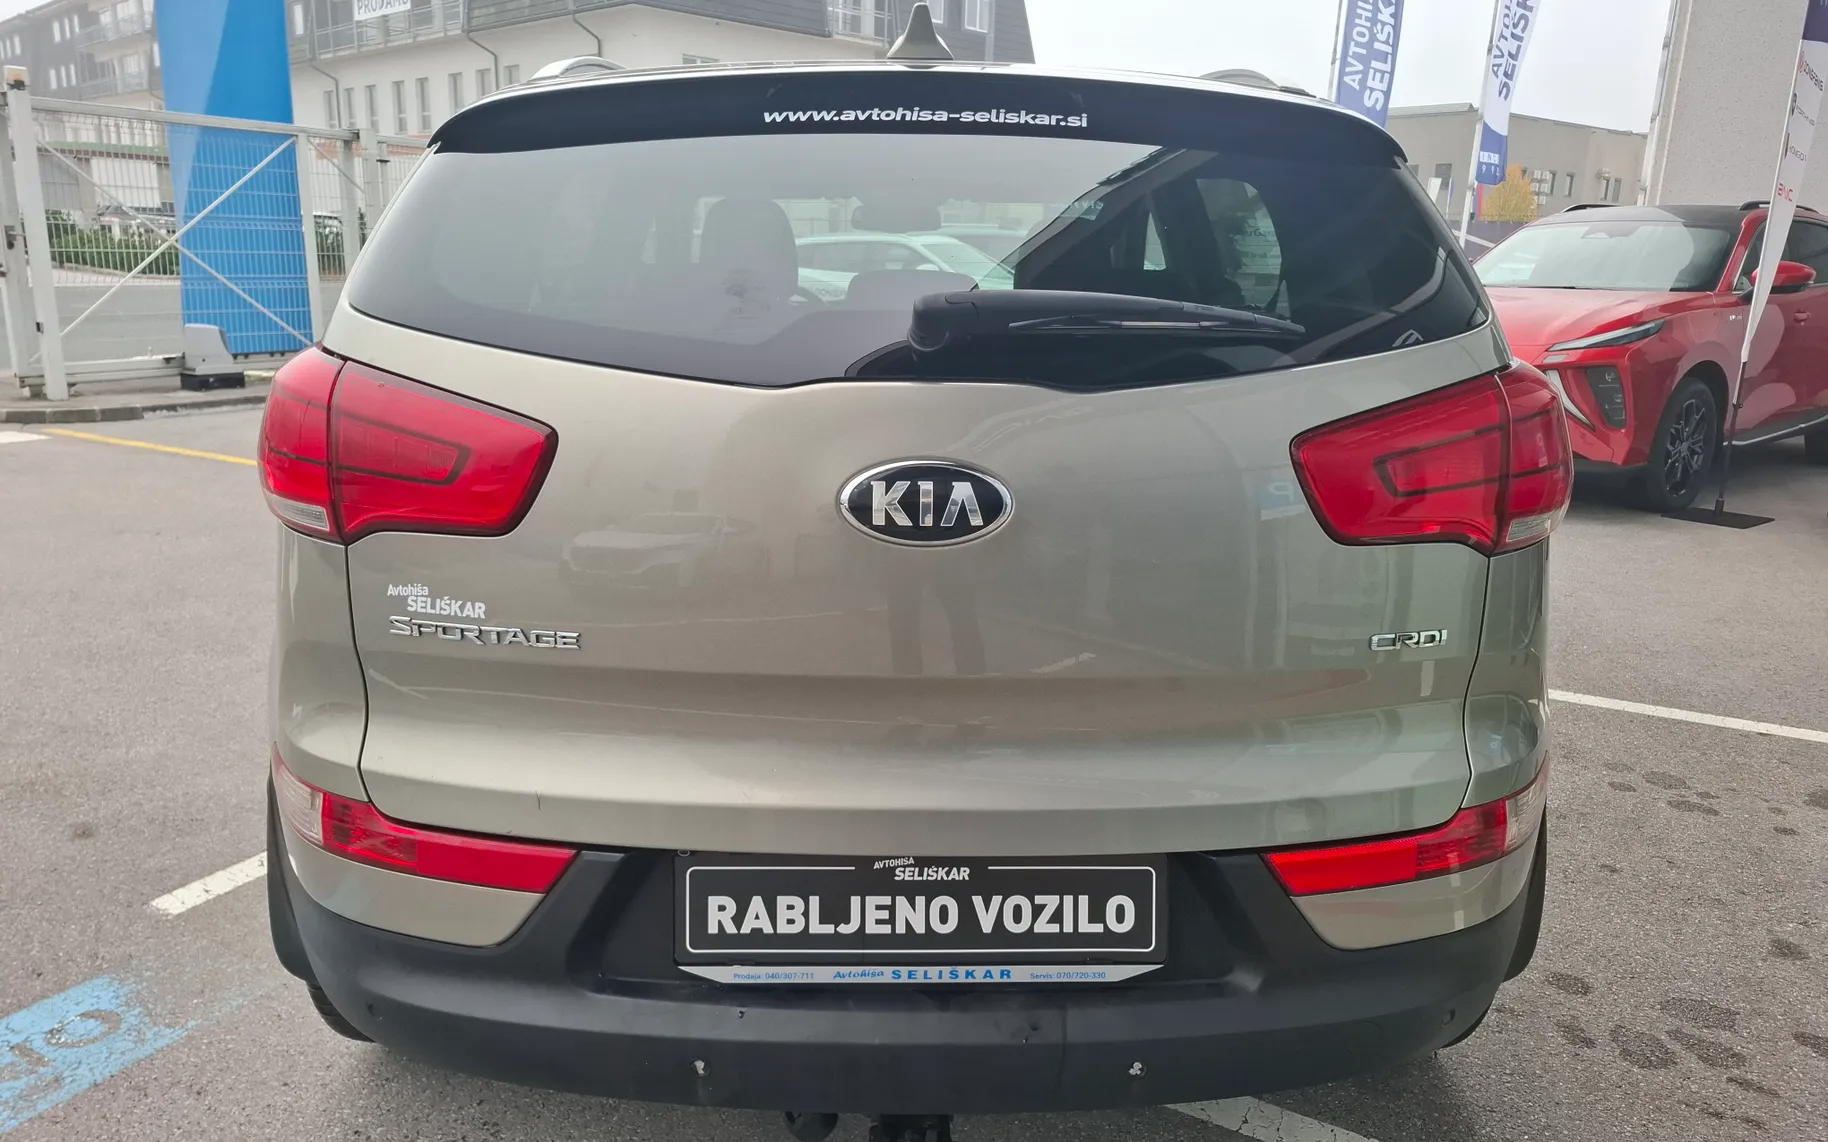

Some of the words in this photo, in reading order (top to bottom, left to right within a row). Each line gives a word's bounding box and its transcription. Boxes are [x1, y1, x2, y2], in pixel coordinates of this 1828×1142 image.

[1343, 0, 1373, 91] AVTOHI
[1363, 0, 1395, 111] SELIŠK
[763, 107, 1088, 127] www.avtohisa-seliskar.si
[870, 480, 984, 526] KIA
[387, 583, 429, 596] Avtohiša
[406, 596, 486, 619] SELIŠKAR
[894, 865, 970, 881] SELIŠKAR
[707, 895, 959, 935] RABLJENO
[972, 894, 1136, 934] VOZILO
[833, 969, 884, 980] Avtohiša
[891, 965, 1012, 981] SELIŠKAR
[1056, 971, 1106, 980] 070/720-330
